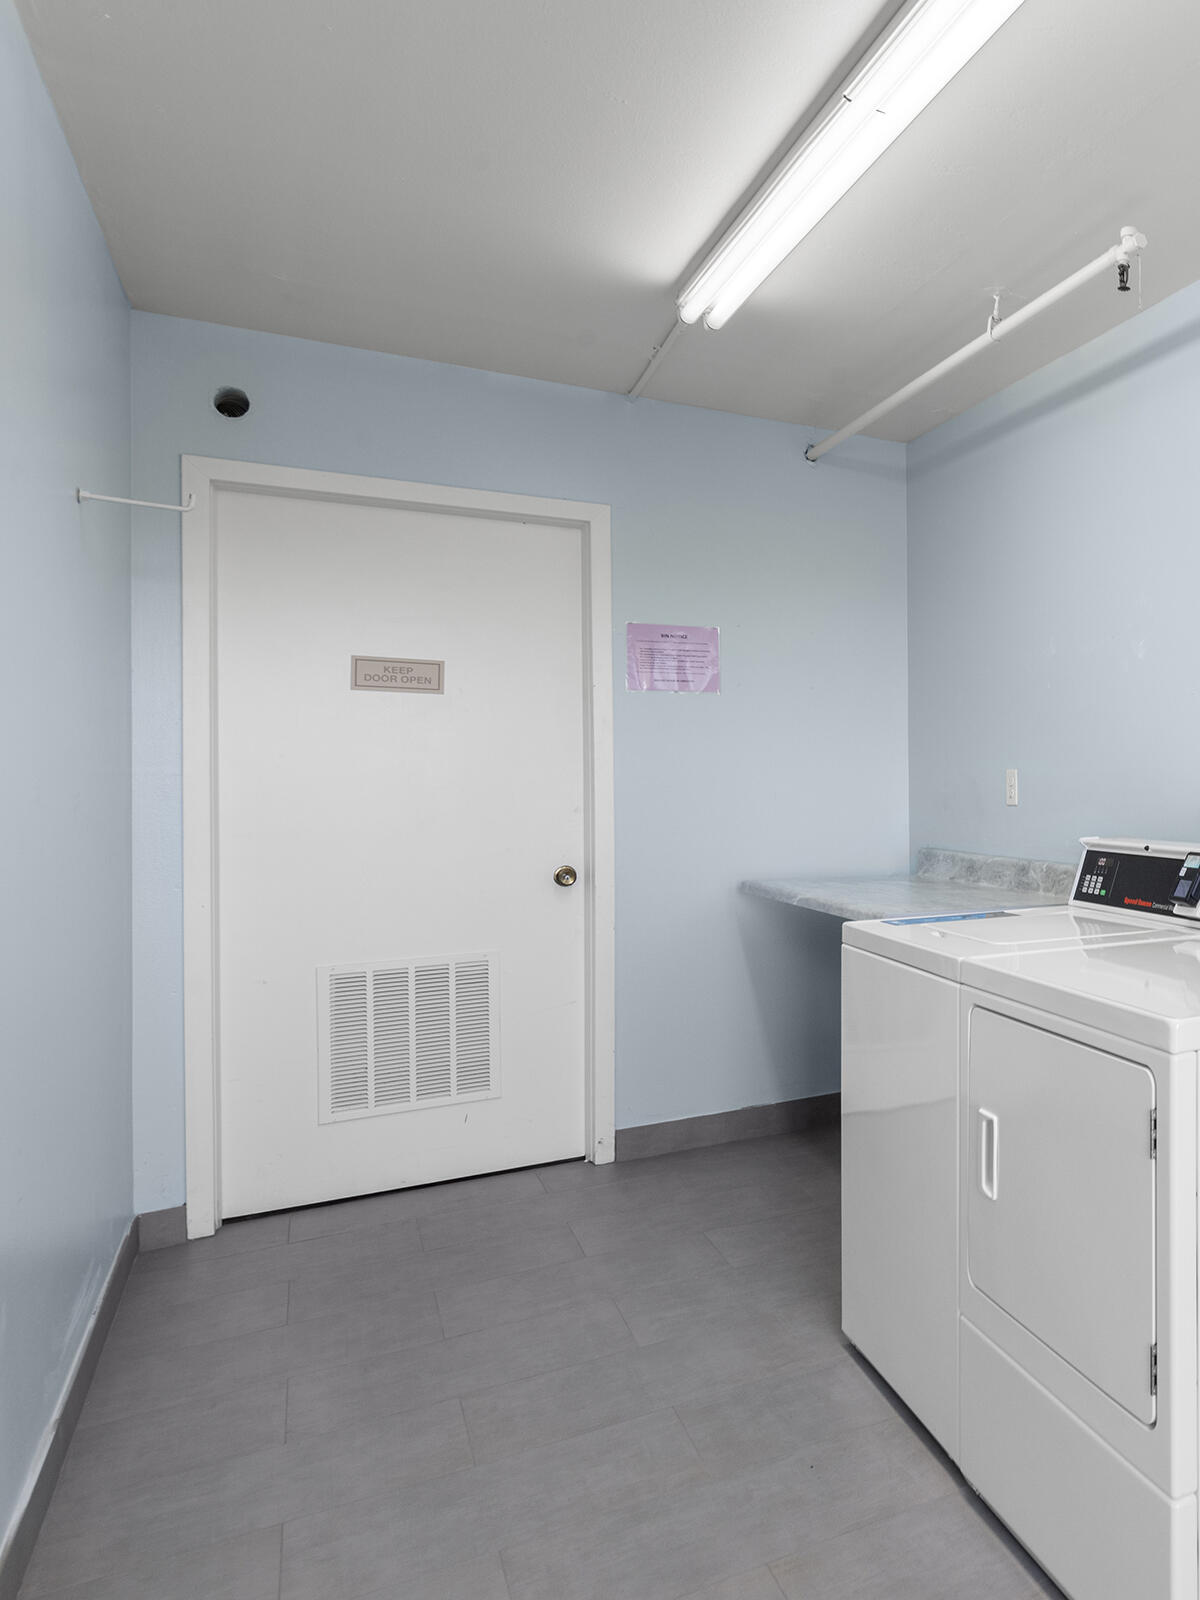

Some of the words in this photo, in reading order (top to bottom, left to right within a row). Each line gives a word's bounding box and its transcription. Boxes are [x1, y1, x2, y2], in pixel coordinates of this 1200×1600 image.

[383, 665, 414, 675] KEEP
[364, 673, 398, 683] DOOR
[400, 675, 432, 685] OPEN
[1124, 896, 1138, 905] Speed
[1138, 898, 1152, 907] Queen
